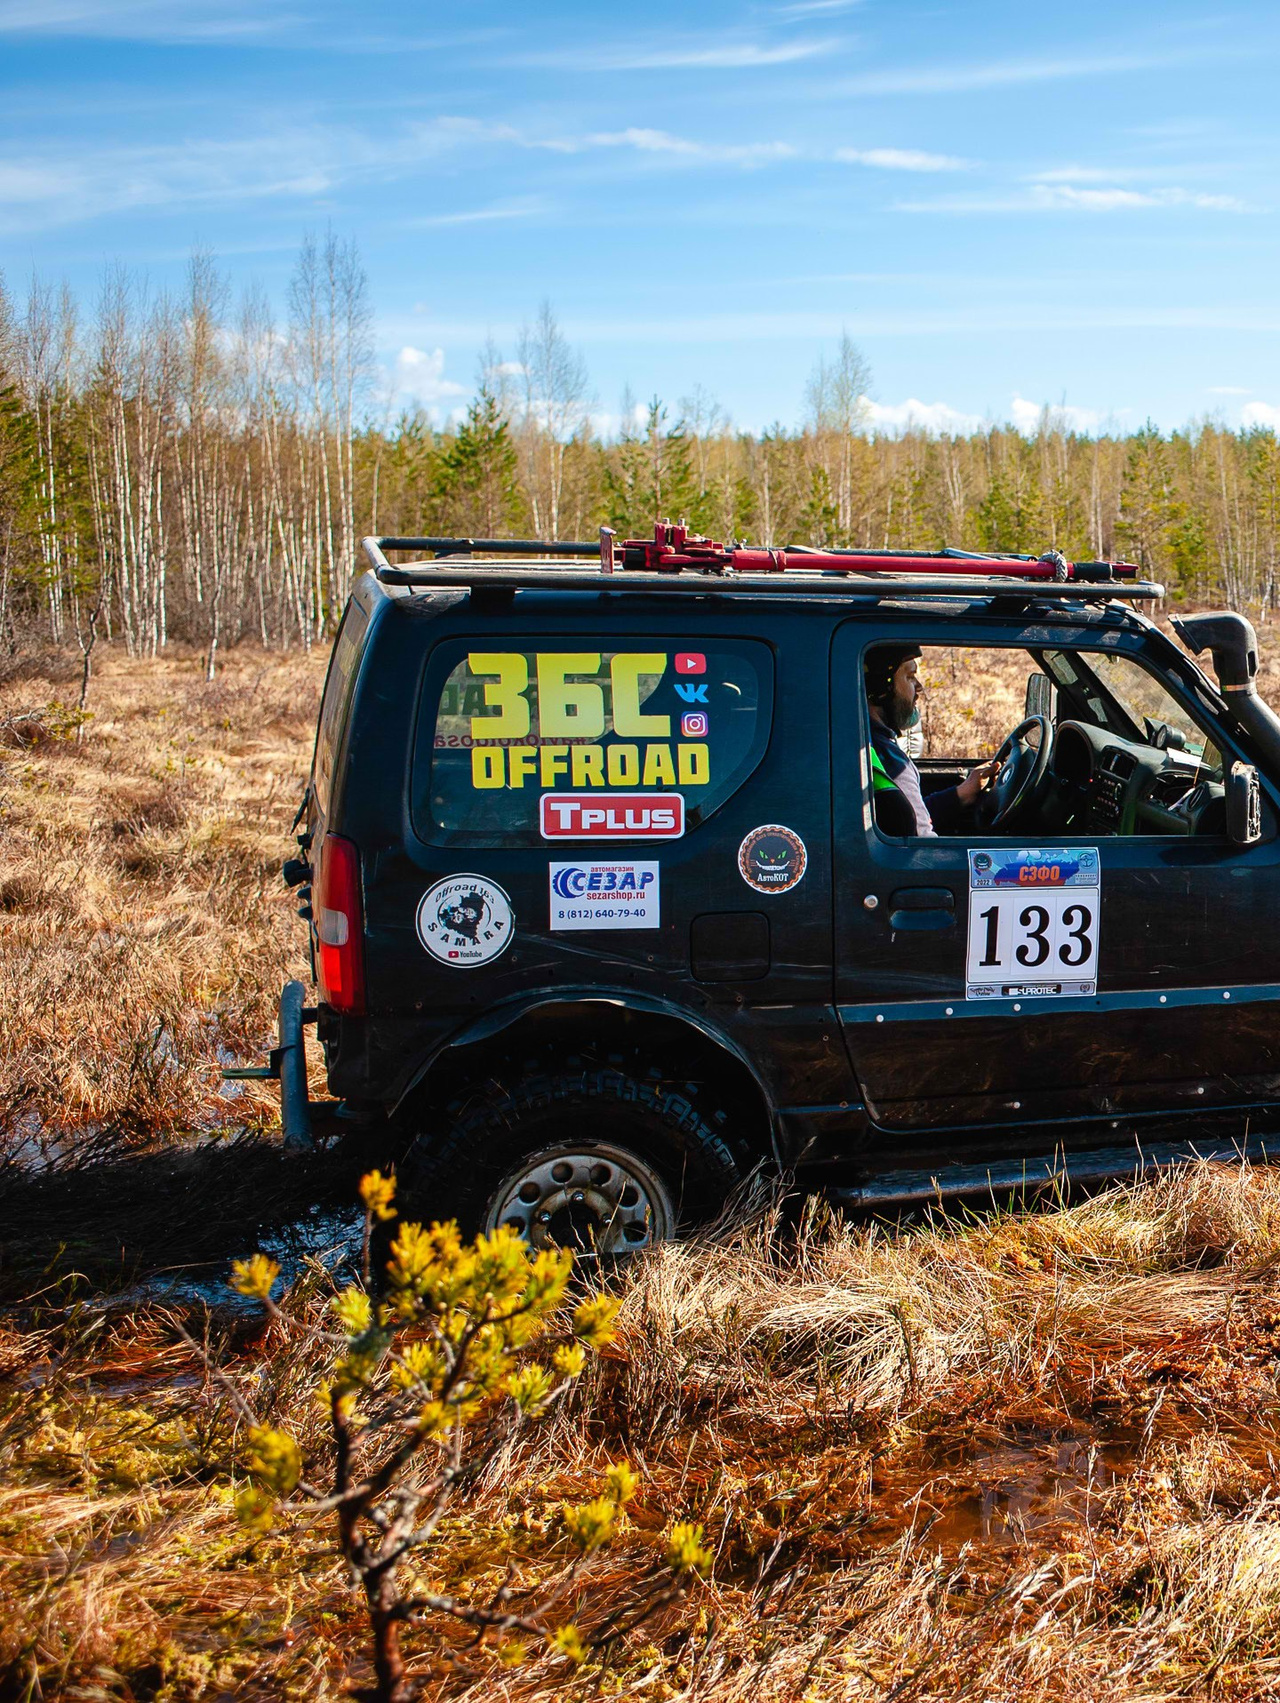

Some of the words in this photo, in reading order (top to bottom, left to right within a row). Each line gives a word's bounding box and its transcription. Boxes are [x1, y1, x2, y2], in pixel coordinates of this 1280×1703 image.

[471, 743, 710, 789] OFFROAD
[550, 802, 675, 830] TPLUS
[572, 872, 655, 892] СЕЗАР
[1019, 865, 1060, 881] СЗФО
[435, 884, 478, 903] Offroad
[586, 891, 646, 901] sezarshop.ru
[558, 910, 565, 919] 8
[567, 910, 593, 920] (812)
[595, 908, 646, 918] 640-79-40
[427, 920, 504, 947] SAMARA
[979, 904, 1093, 967] 133
[459, 950, 482, 958] YouTube
